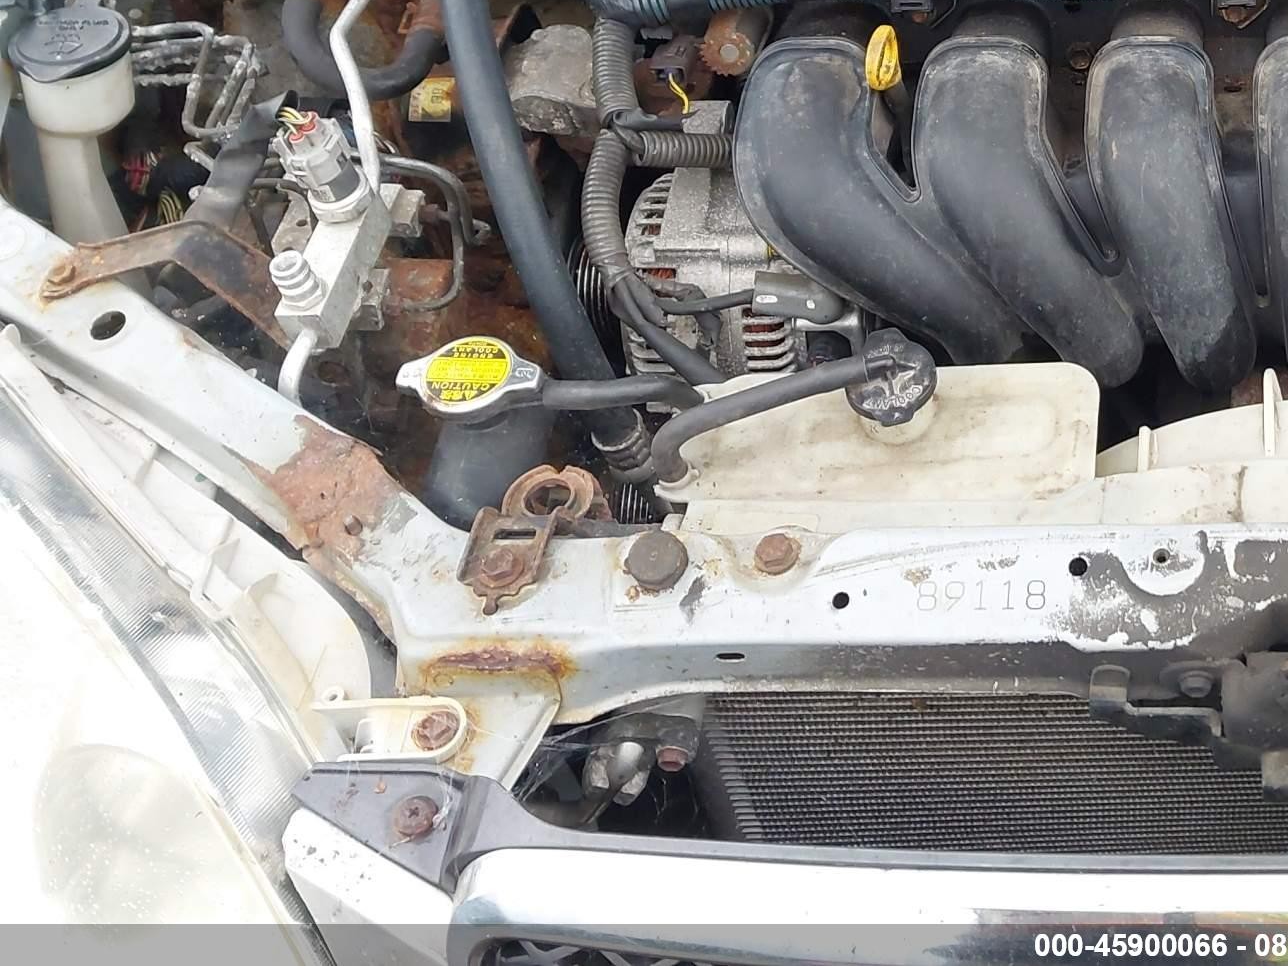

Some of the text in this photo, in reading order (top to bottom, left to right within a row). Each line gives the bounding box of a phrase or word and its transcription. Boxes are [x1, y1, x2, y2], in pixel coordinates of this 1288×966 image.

[452, 346, 498, 354] COOLANT
[431, 381, 490, 391] CAUTION
[916, 579, 1046, 612] 89118
